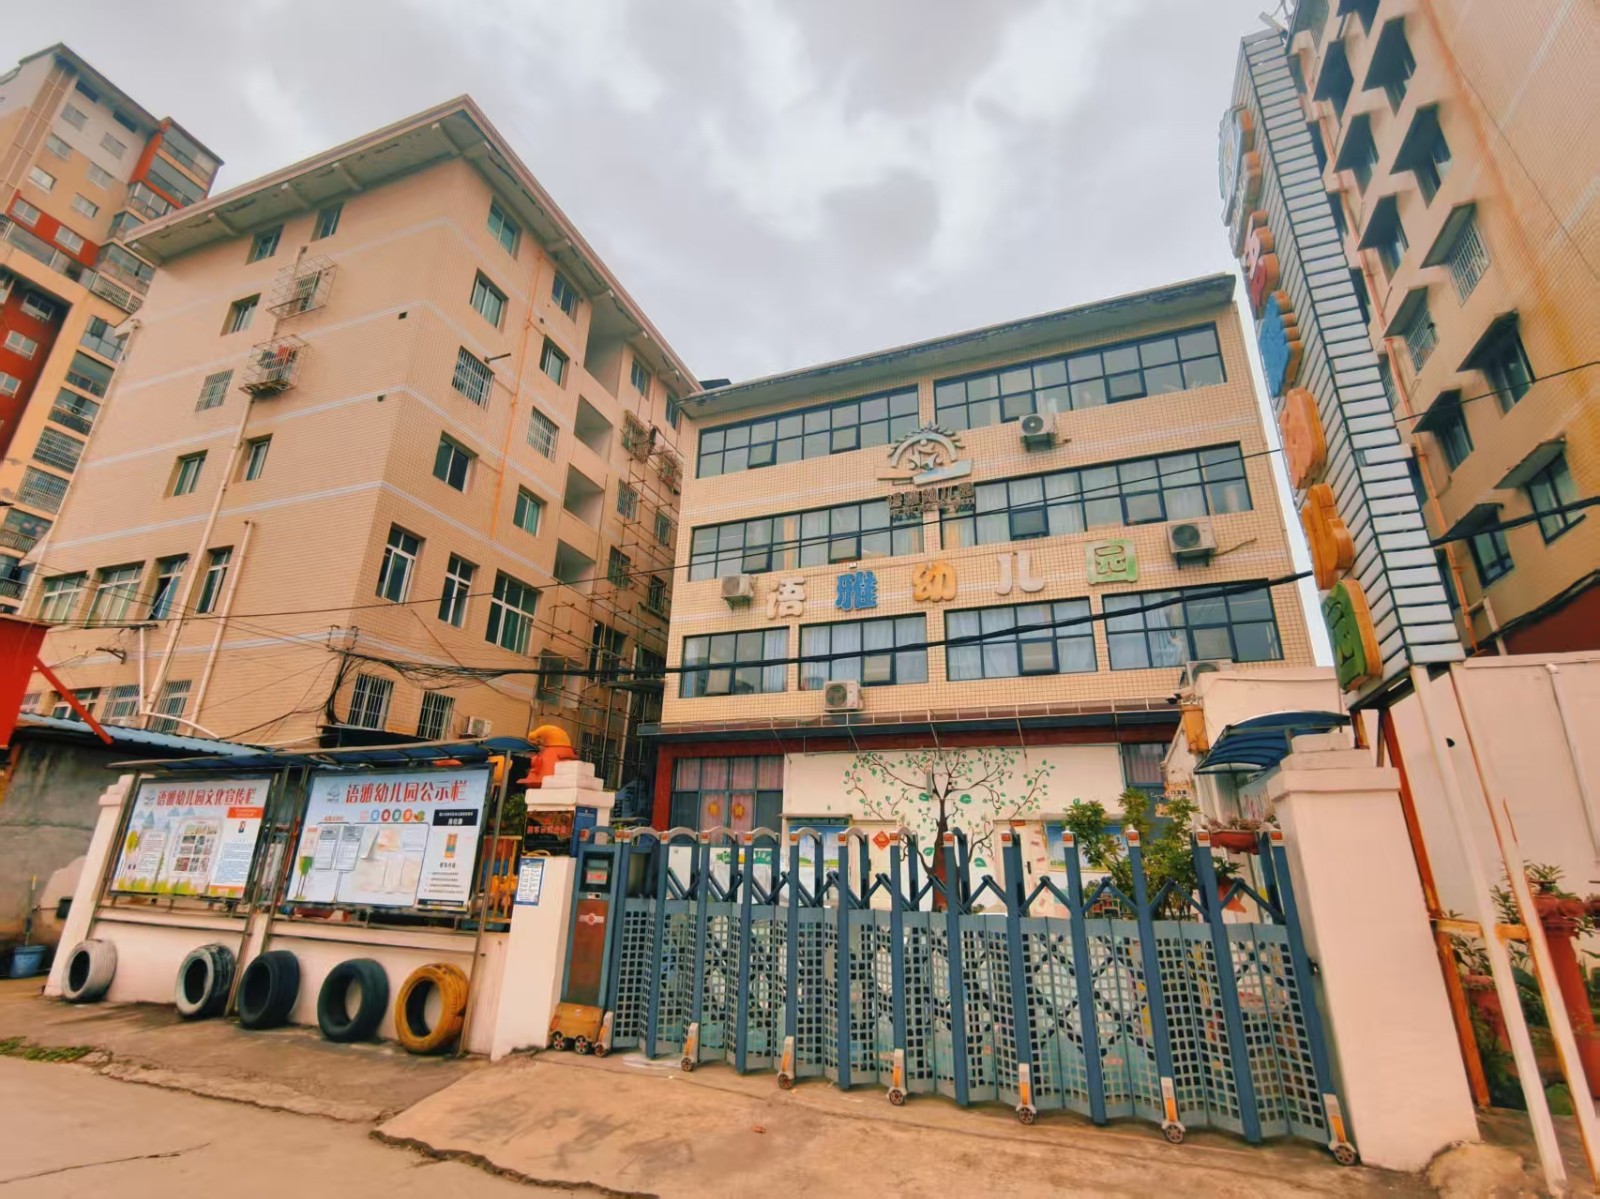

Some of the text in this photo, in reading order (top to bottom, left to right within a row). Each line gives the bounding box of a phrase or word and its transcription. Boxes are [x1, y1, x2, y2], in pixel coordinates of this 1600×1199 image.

[766, 538, 1140, 620] 语雅幼儿园
[156, 787, 257, 807] 语雅幼儿园文化宣传栏
[346, 780, 468, 804] 语雅幼儿园公示栏
